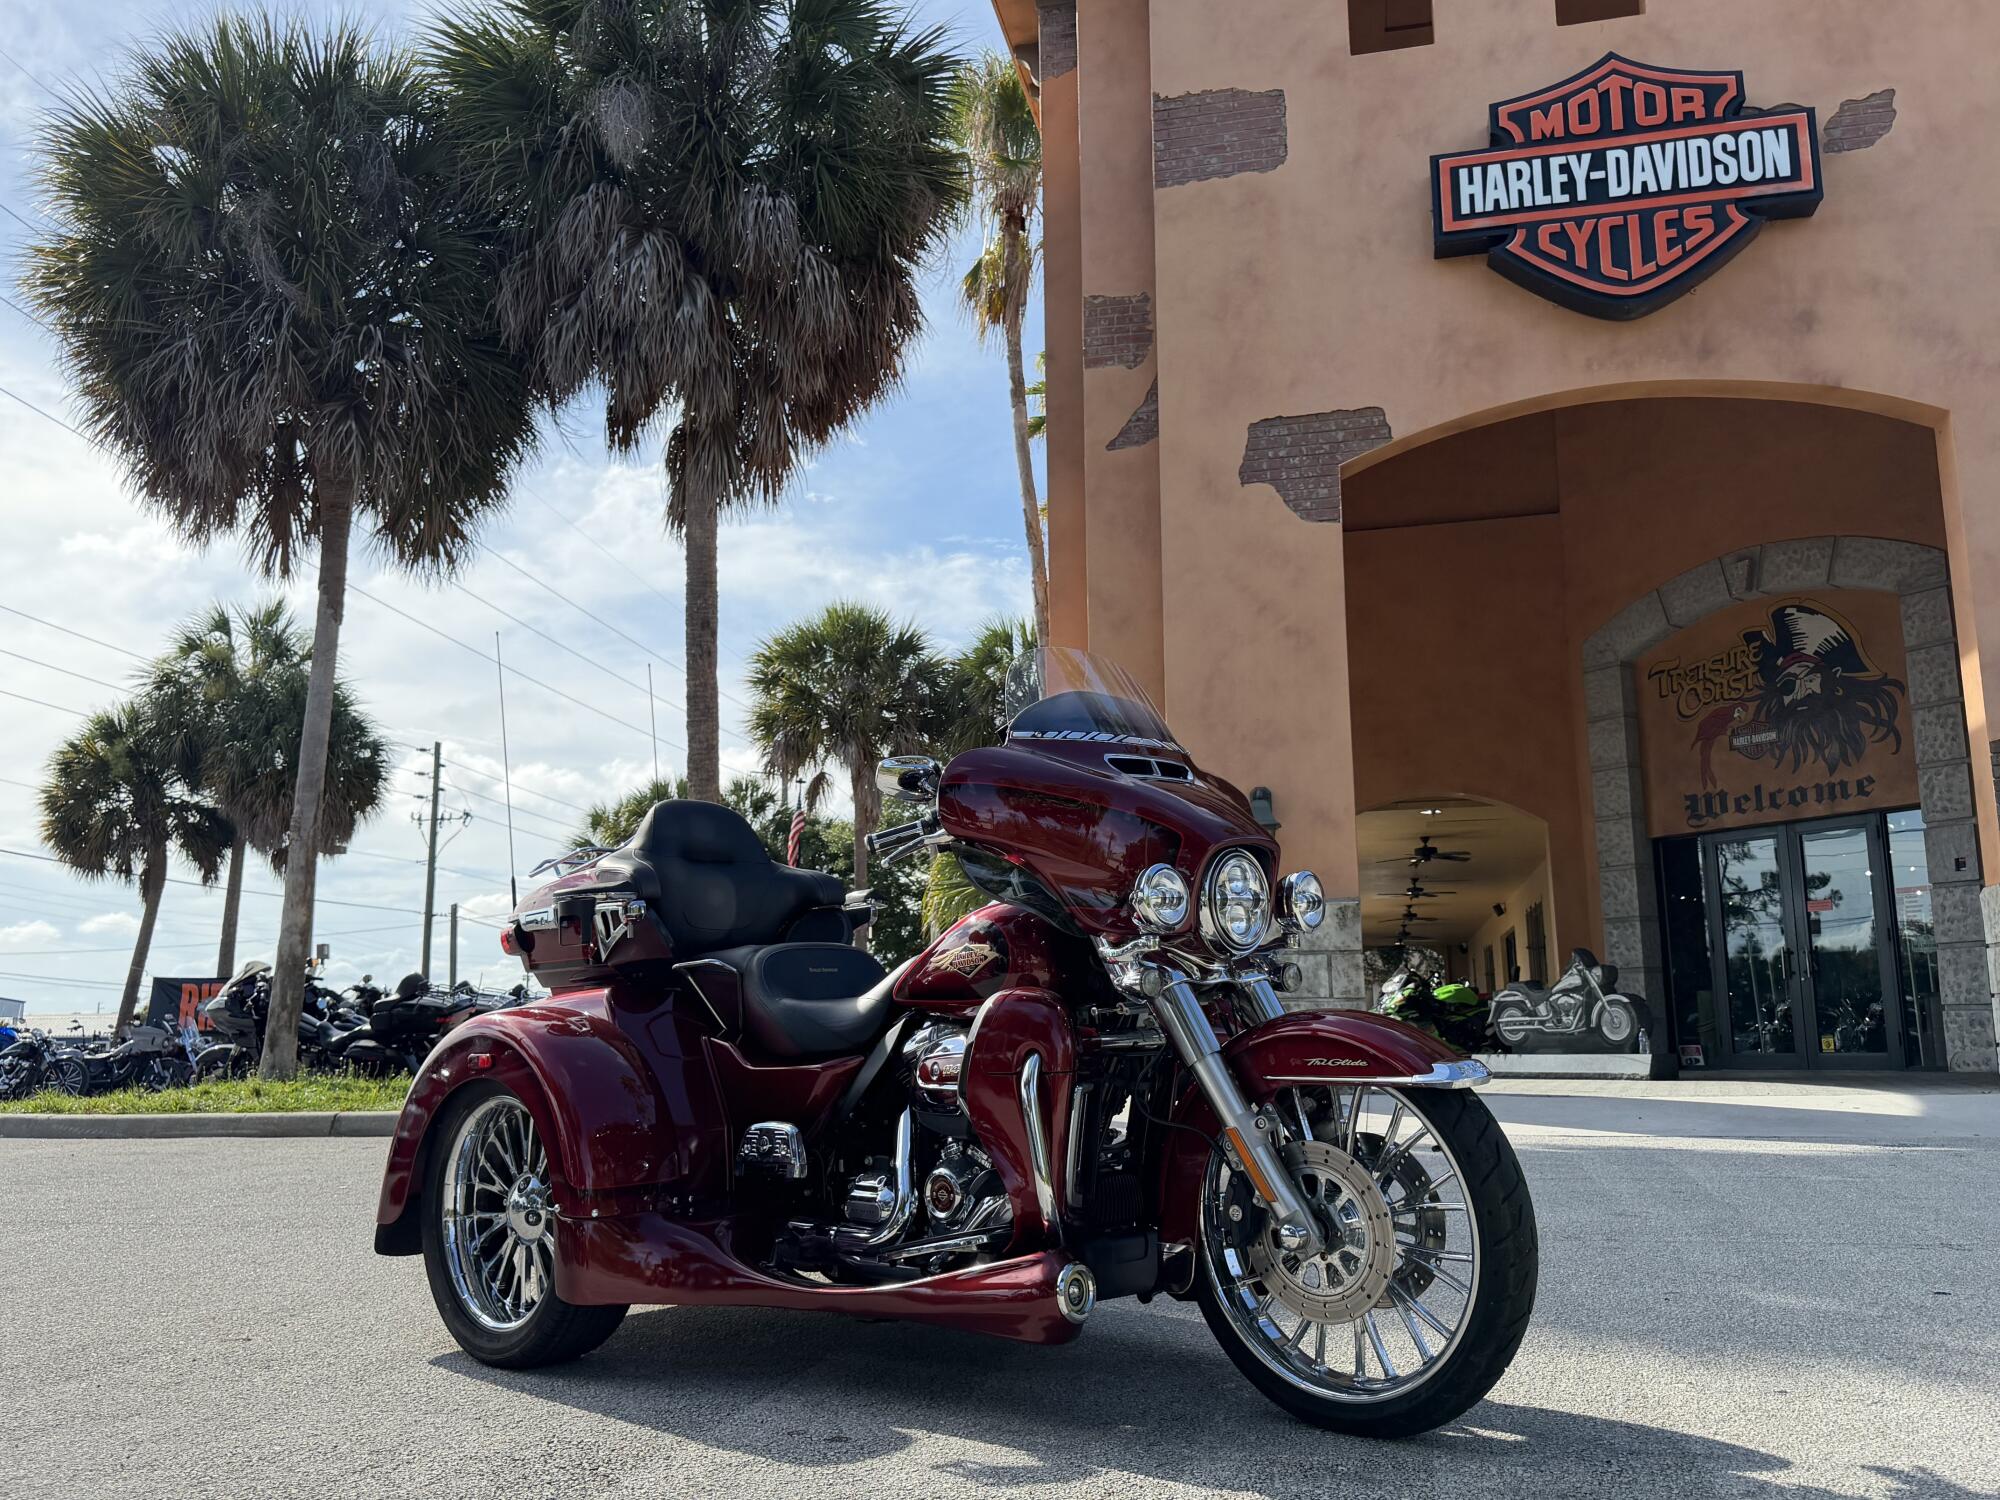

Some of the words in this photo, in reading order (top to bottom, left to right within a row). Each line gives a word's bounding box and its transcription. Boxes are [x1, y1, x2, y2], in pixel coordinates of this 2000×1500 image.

[1530, 74, 1706, 141] MOTOR
[1459, 128, 1792, 215] HARLEY-DAVIDSON
[1538, 205, 1715, 281] CYCLES
[1684, 774, 1876, 828] Welcome
